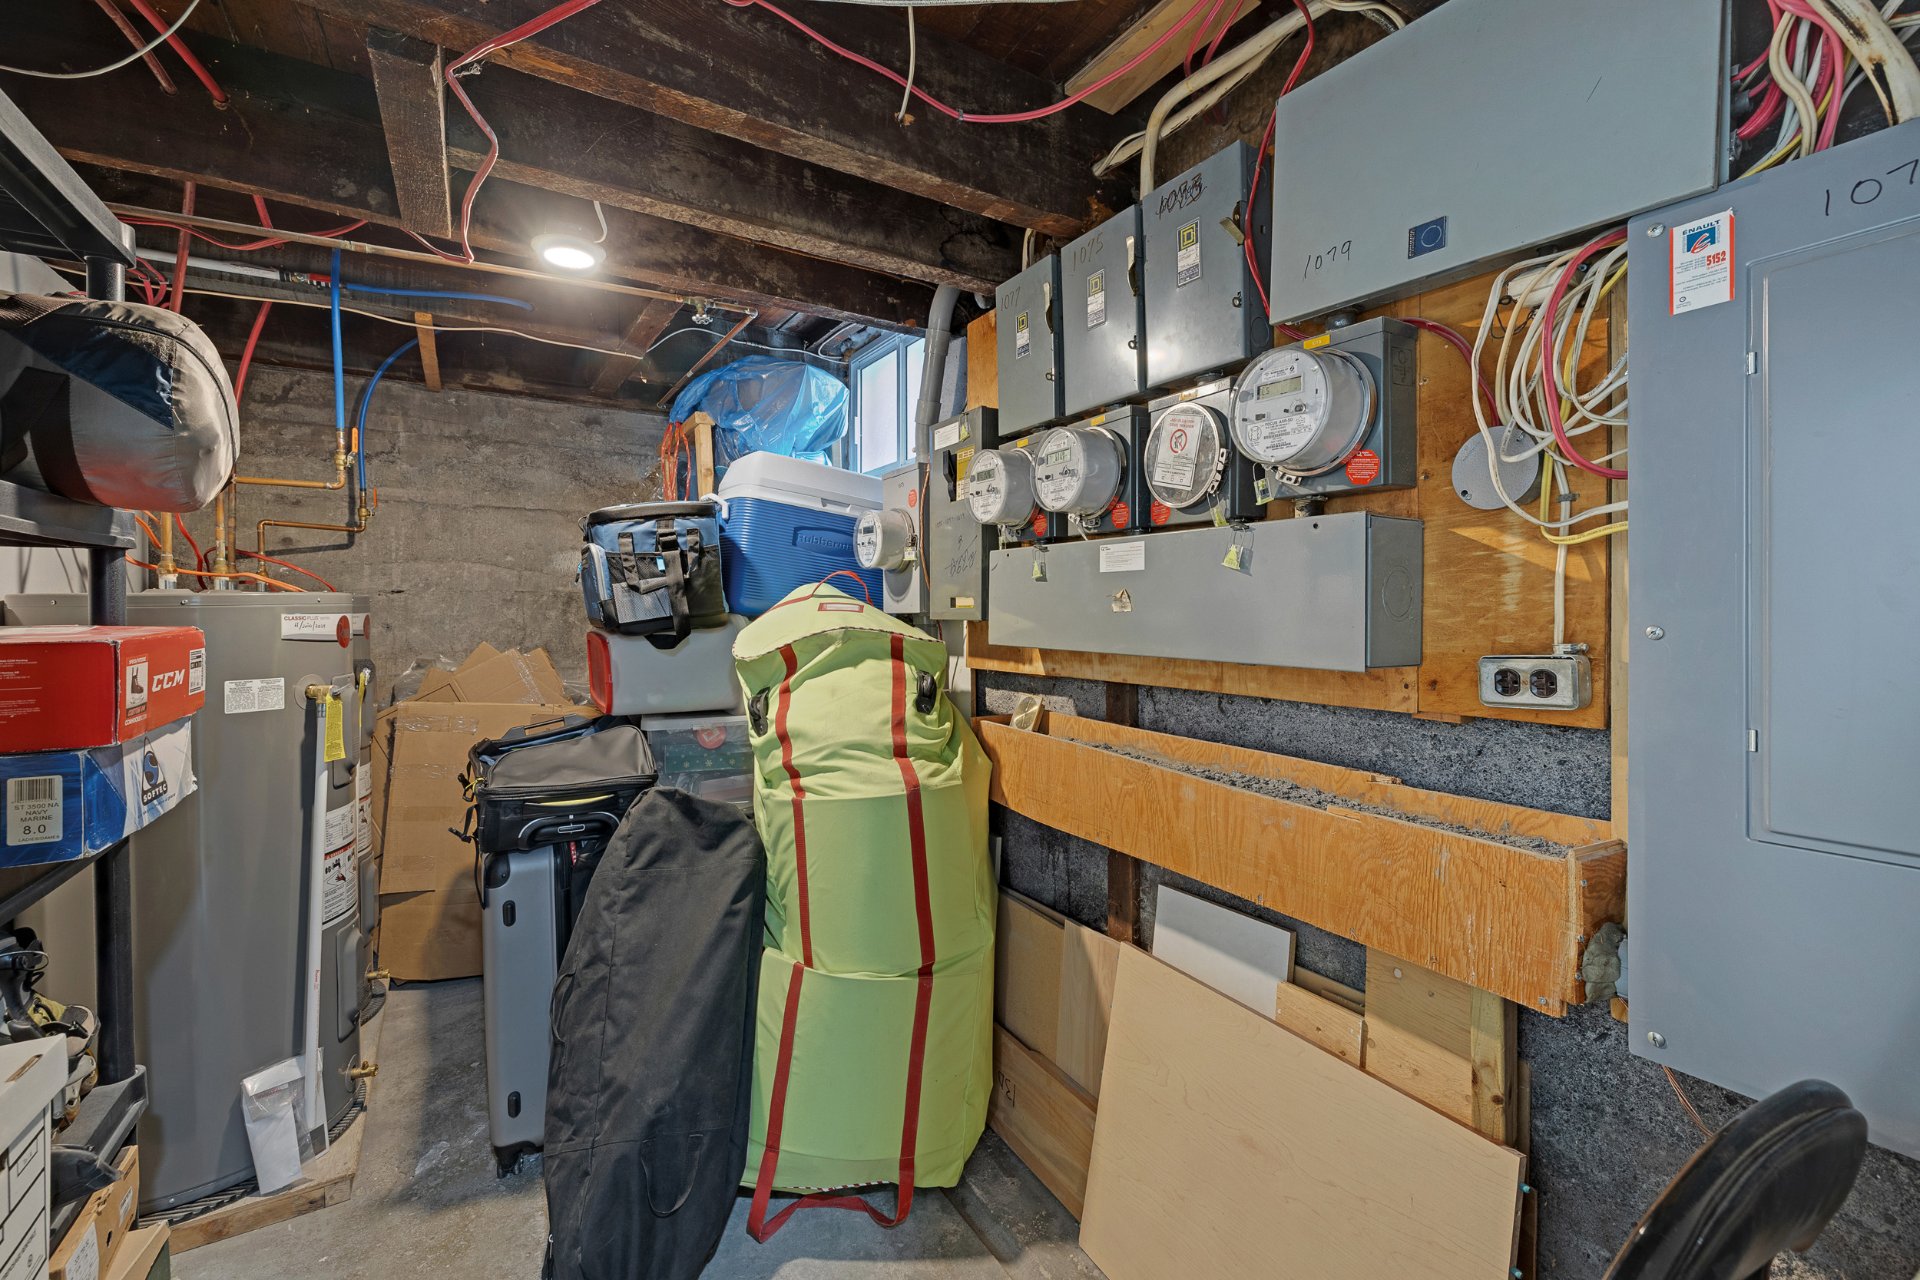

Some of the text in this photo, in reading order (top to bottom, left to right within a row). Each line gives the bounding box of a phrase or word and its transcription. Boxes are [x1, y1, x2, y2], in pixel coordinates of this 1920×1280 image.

[1682, 219, 1721, 236] ENAULT
[1073, 231, 1105, 271] 1075
[1303, 240, 1352, 280] 1079
[1706, 250, 1727, 266] 5152
[151, 668, 186, 693] CCM
[143, 782, 167, 803] SOFTEC
[20, 814, 53, 823] MARINE
[23, 824, 47, 835] 8.0
